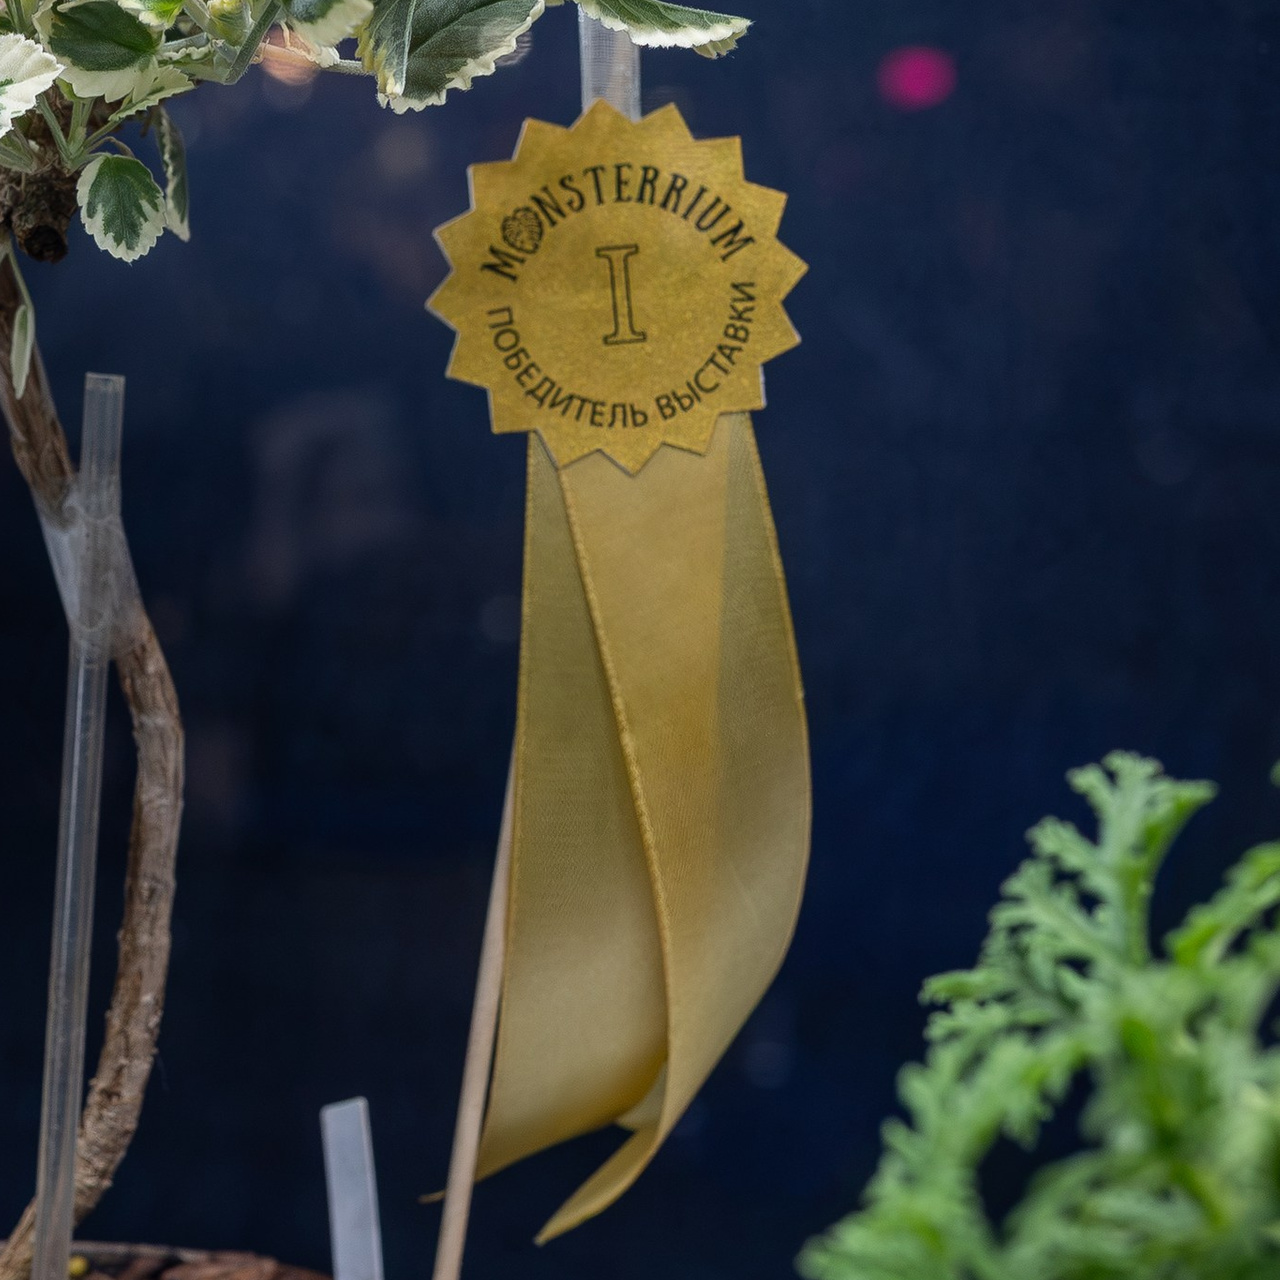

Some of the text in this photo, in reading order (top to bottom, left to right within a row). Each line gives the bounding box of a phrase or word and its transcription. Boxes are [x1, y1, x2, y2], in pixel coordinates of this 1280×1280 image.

[480, 163, 755, 282] MONSTERRIUM
[487, 280, 756, 428] ПОБЕДИТЕЛЬ ВЫСТАВКИ
